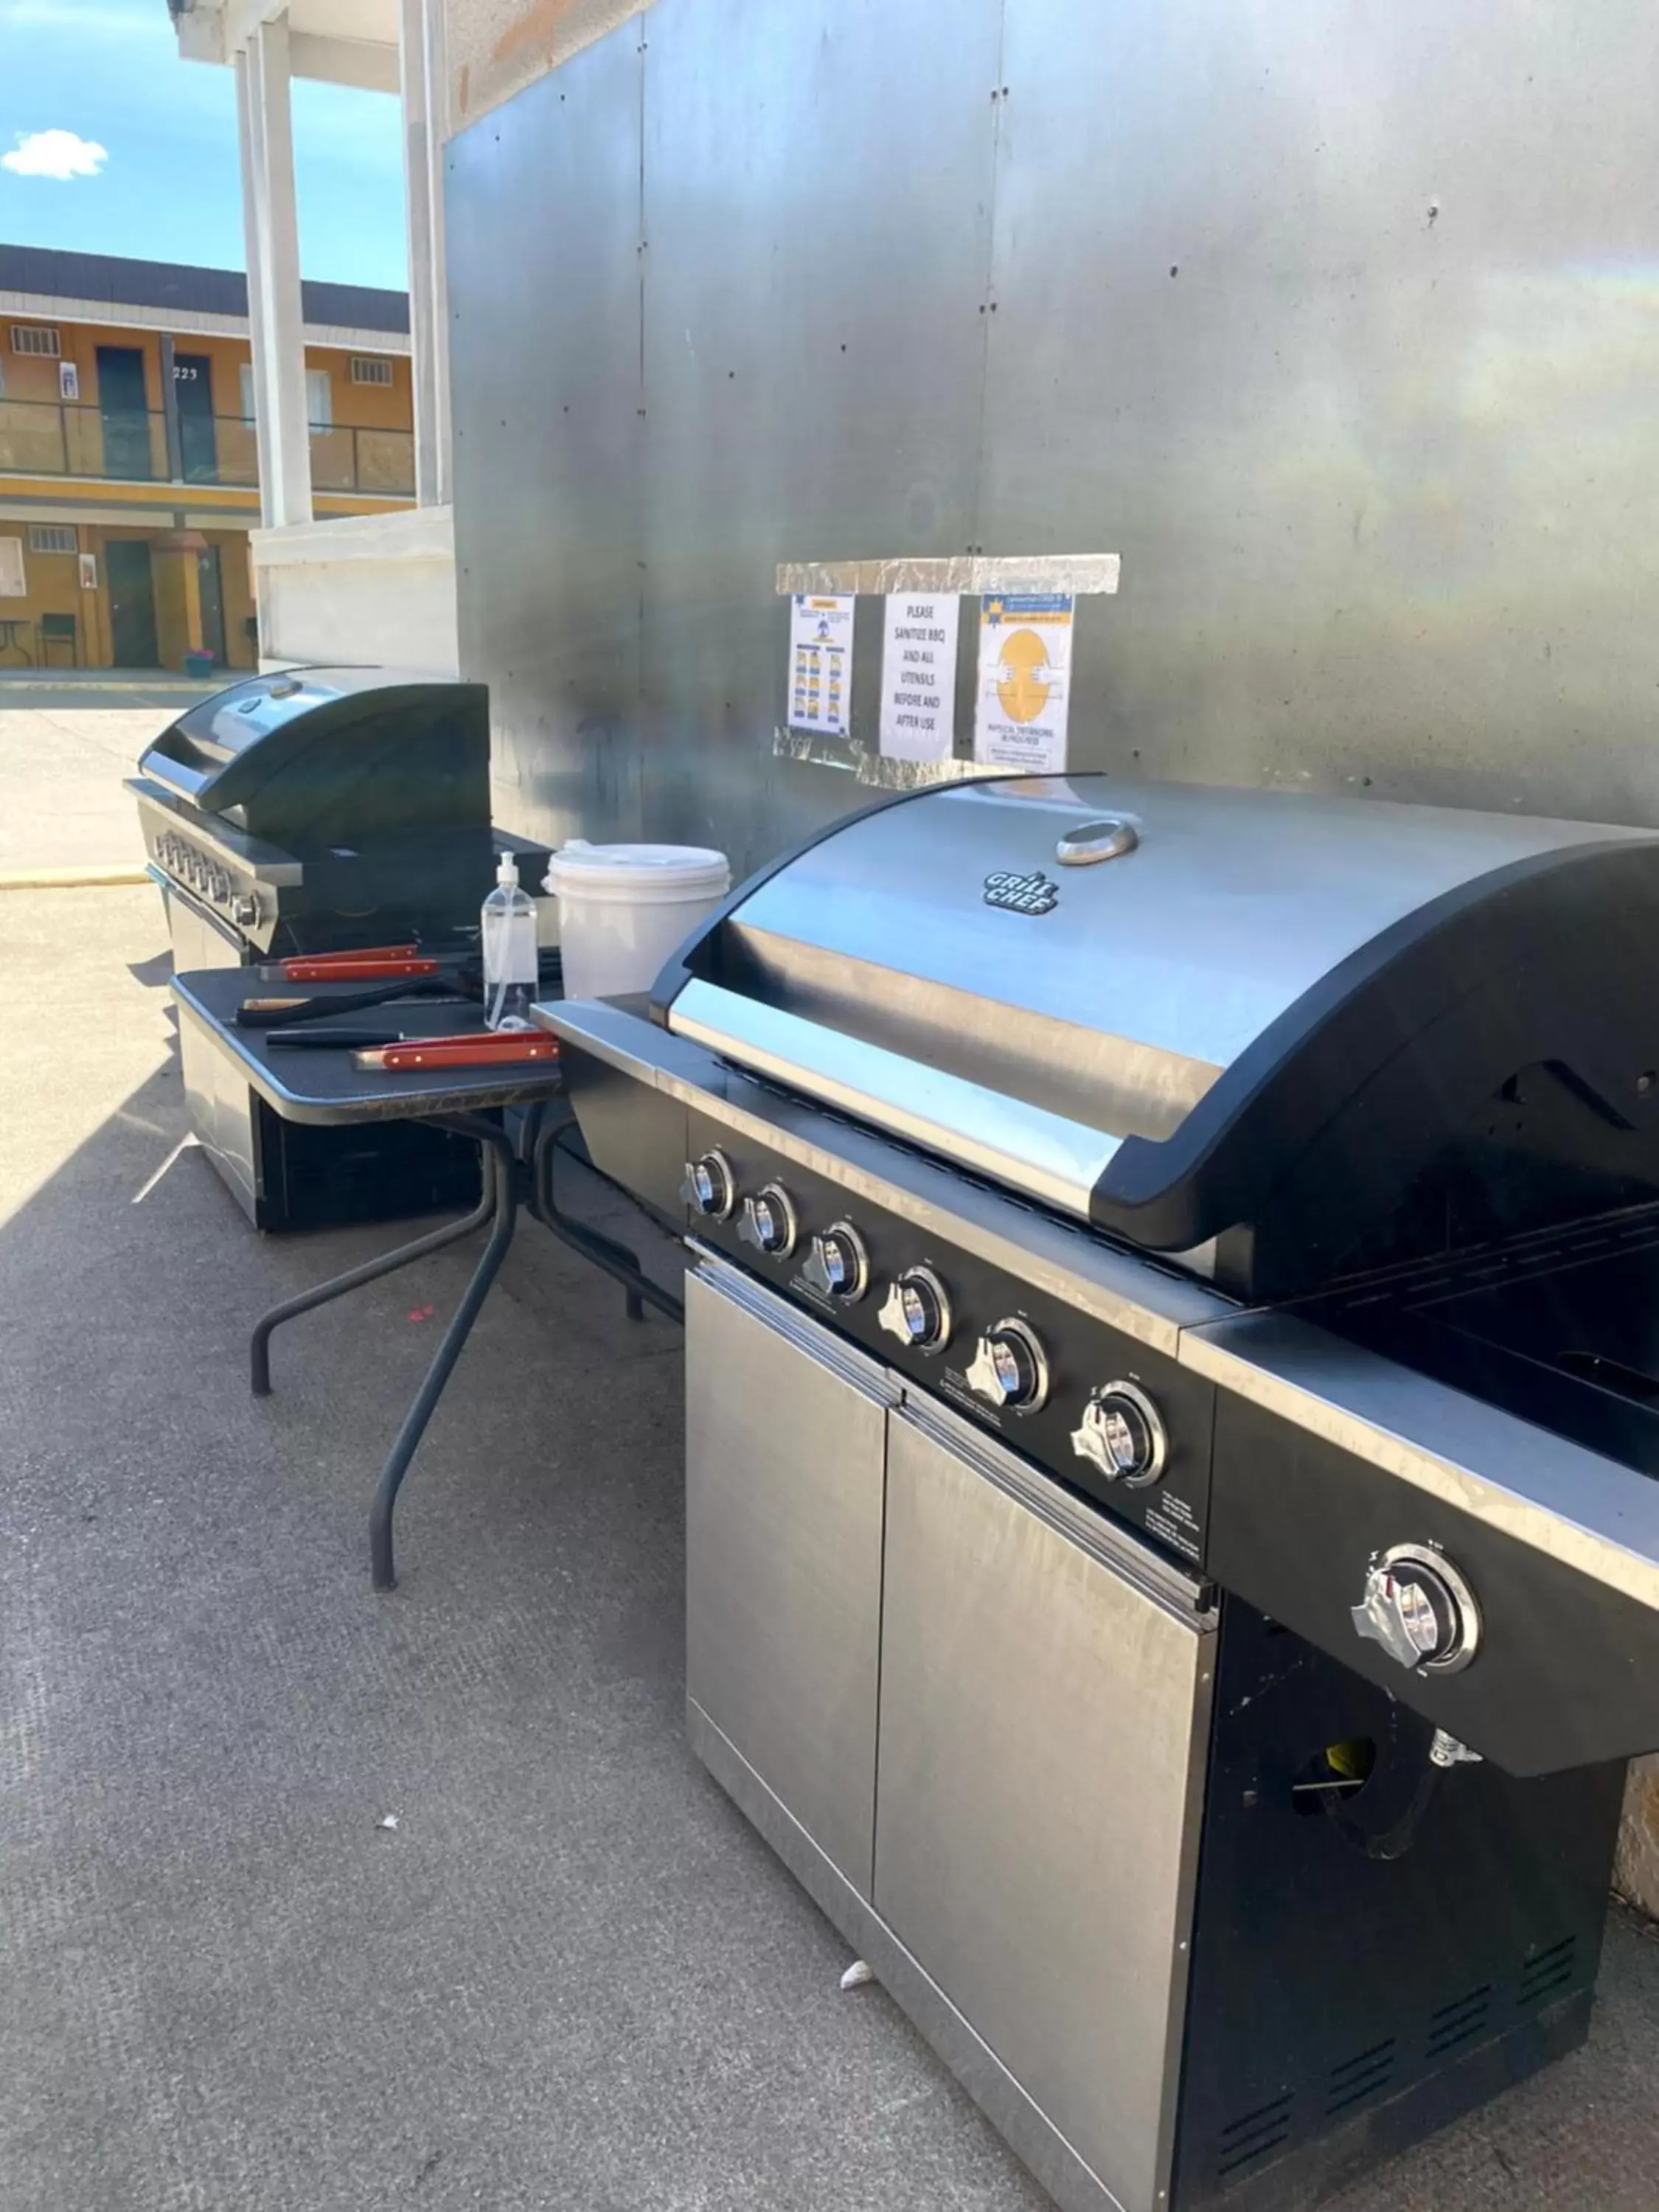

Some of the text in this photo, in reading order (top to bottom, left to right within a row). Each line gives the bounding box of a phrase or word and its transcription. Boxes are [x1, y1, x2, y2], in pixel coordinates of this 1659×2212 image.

[906, 605, 934, 619] PLEASE
[894, 627, 945, 644] SANITIZE BBQ
[903, 650, 935, 664] AND ALL
[900, 672, 936, 686] UTENSILS
[894, 692, 940, 709] BEFORE AND
[896, 714, 936, 731] AFTER USE
[987, 873, 1051, 896] GRILL
[987, 887, 1051, 910] CHEF
